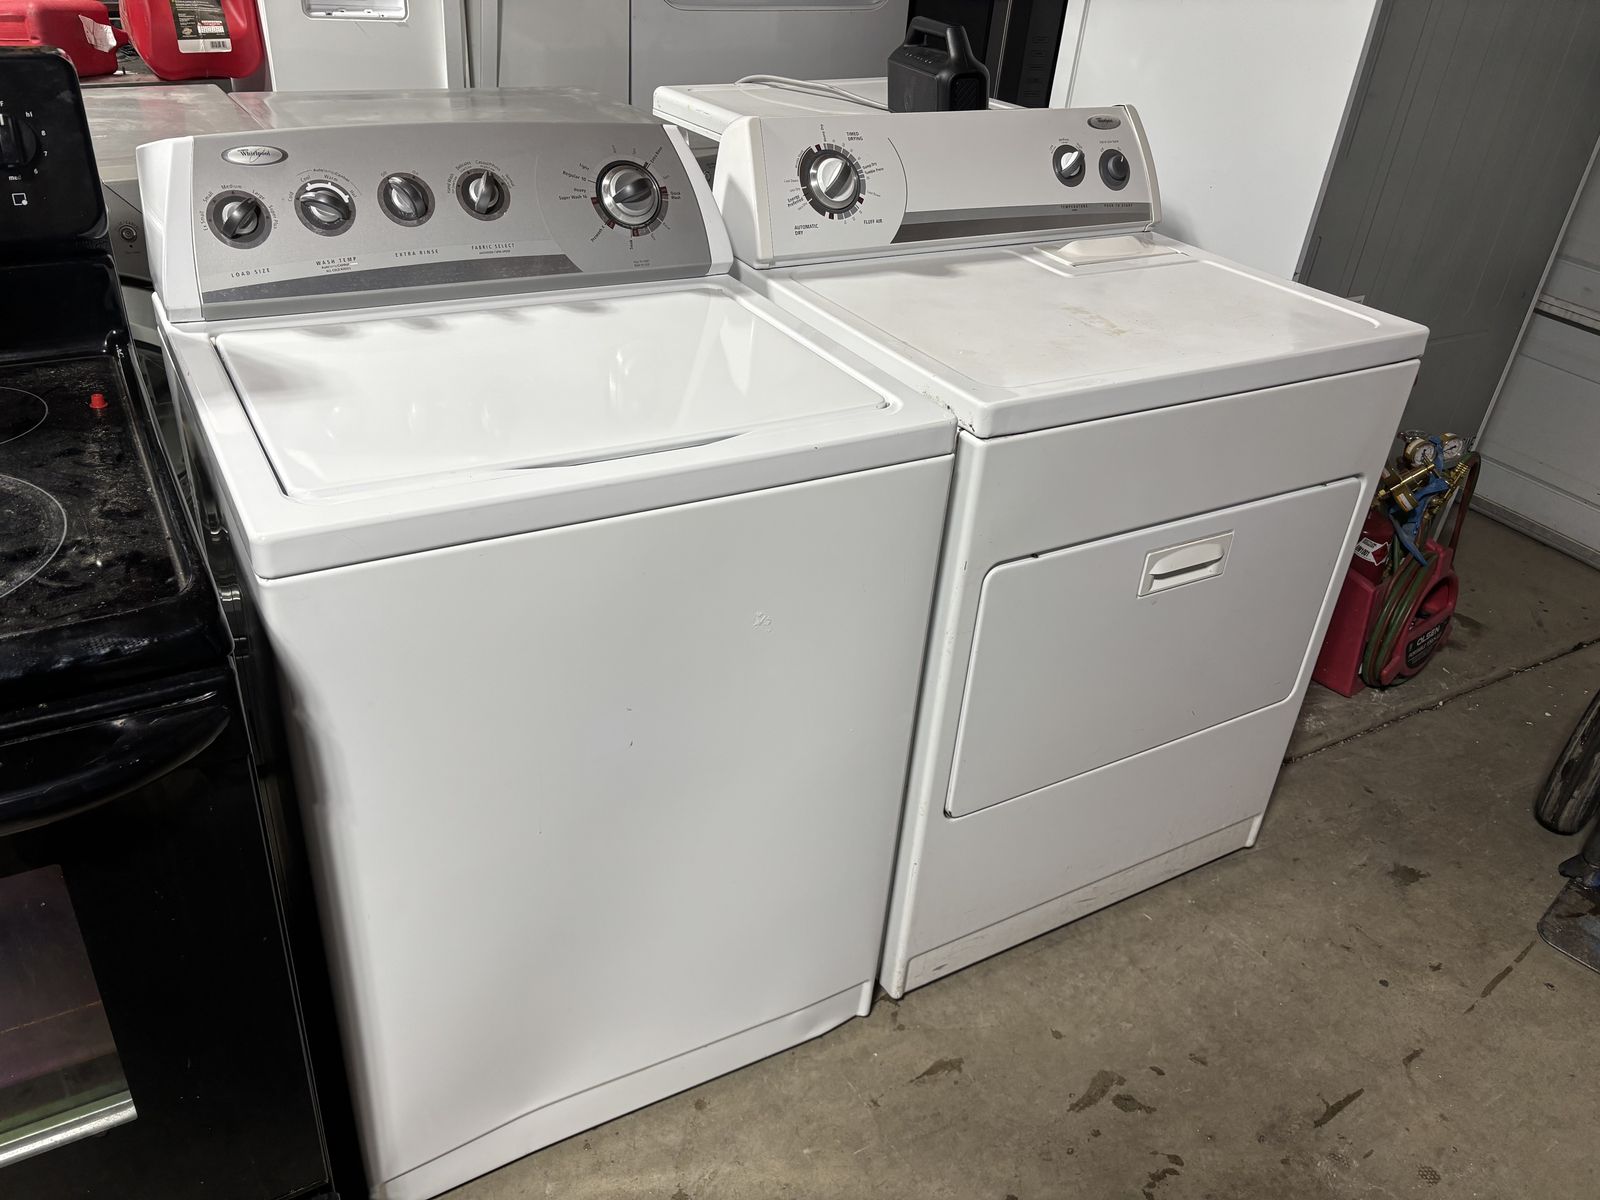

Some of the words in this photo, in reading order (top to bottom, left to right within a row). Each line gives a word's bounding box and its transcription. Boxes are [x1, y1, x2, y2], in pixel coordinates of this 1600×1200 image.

[562, 170, 582, 180] Regular
[394, 250, 416, 258] EXTRA
[231, 270, 251, 278] LOAD
[254, 267, 270, 275] SIZE
